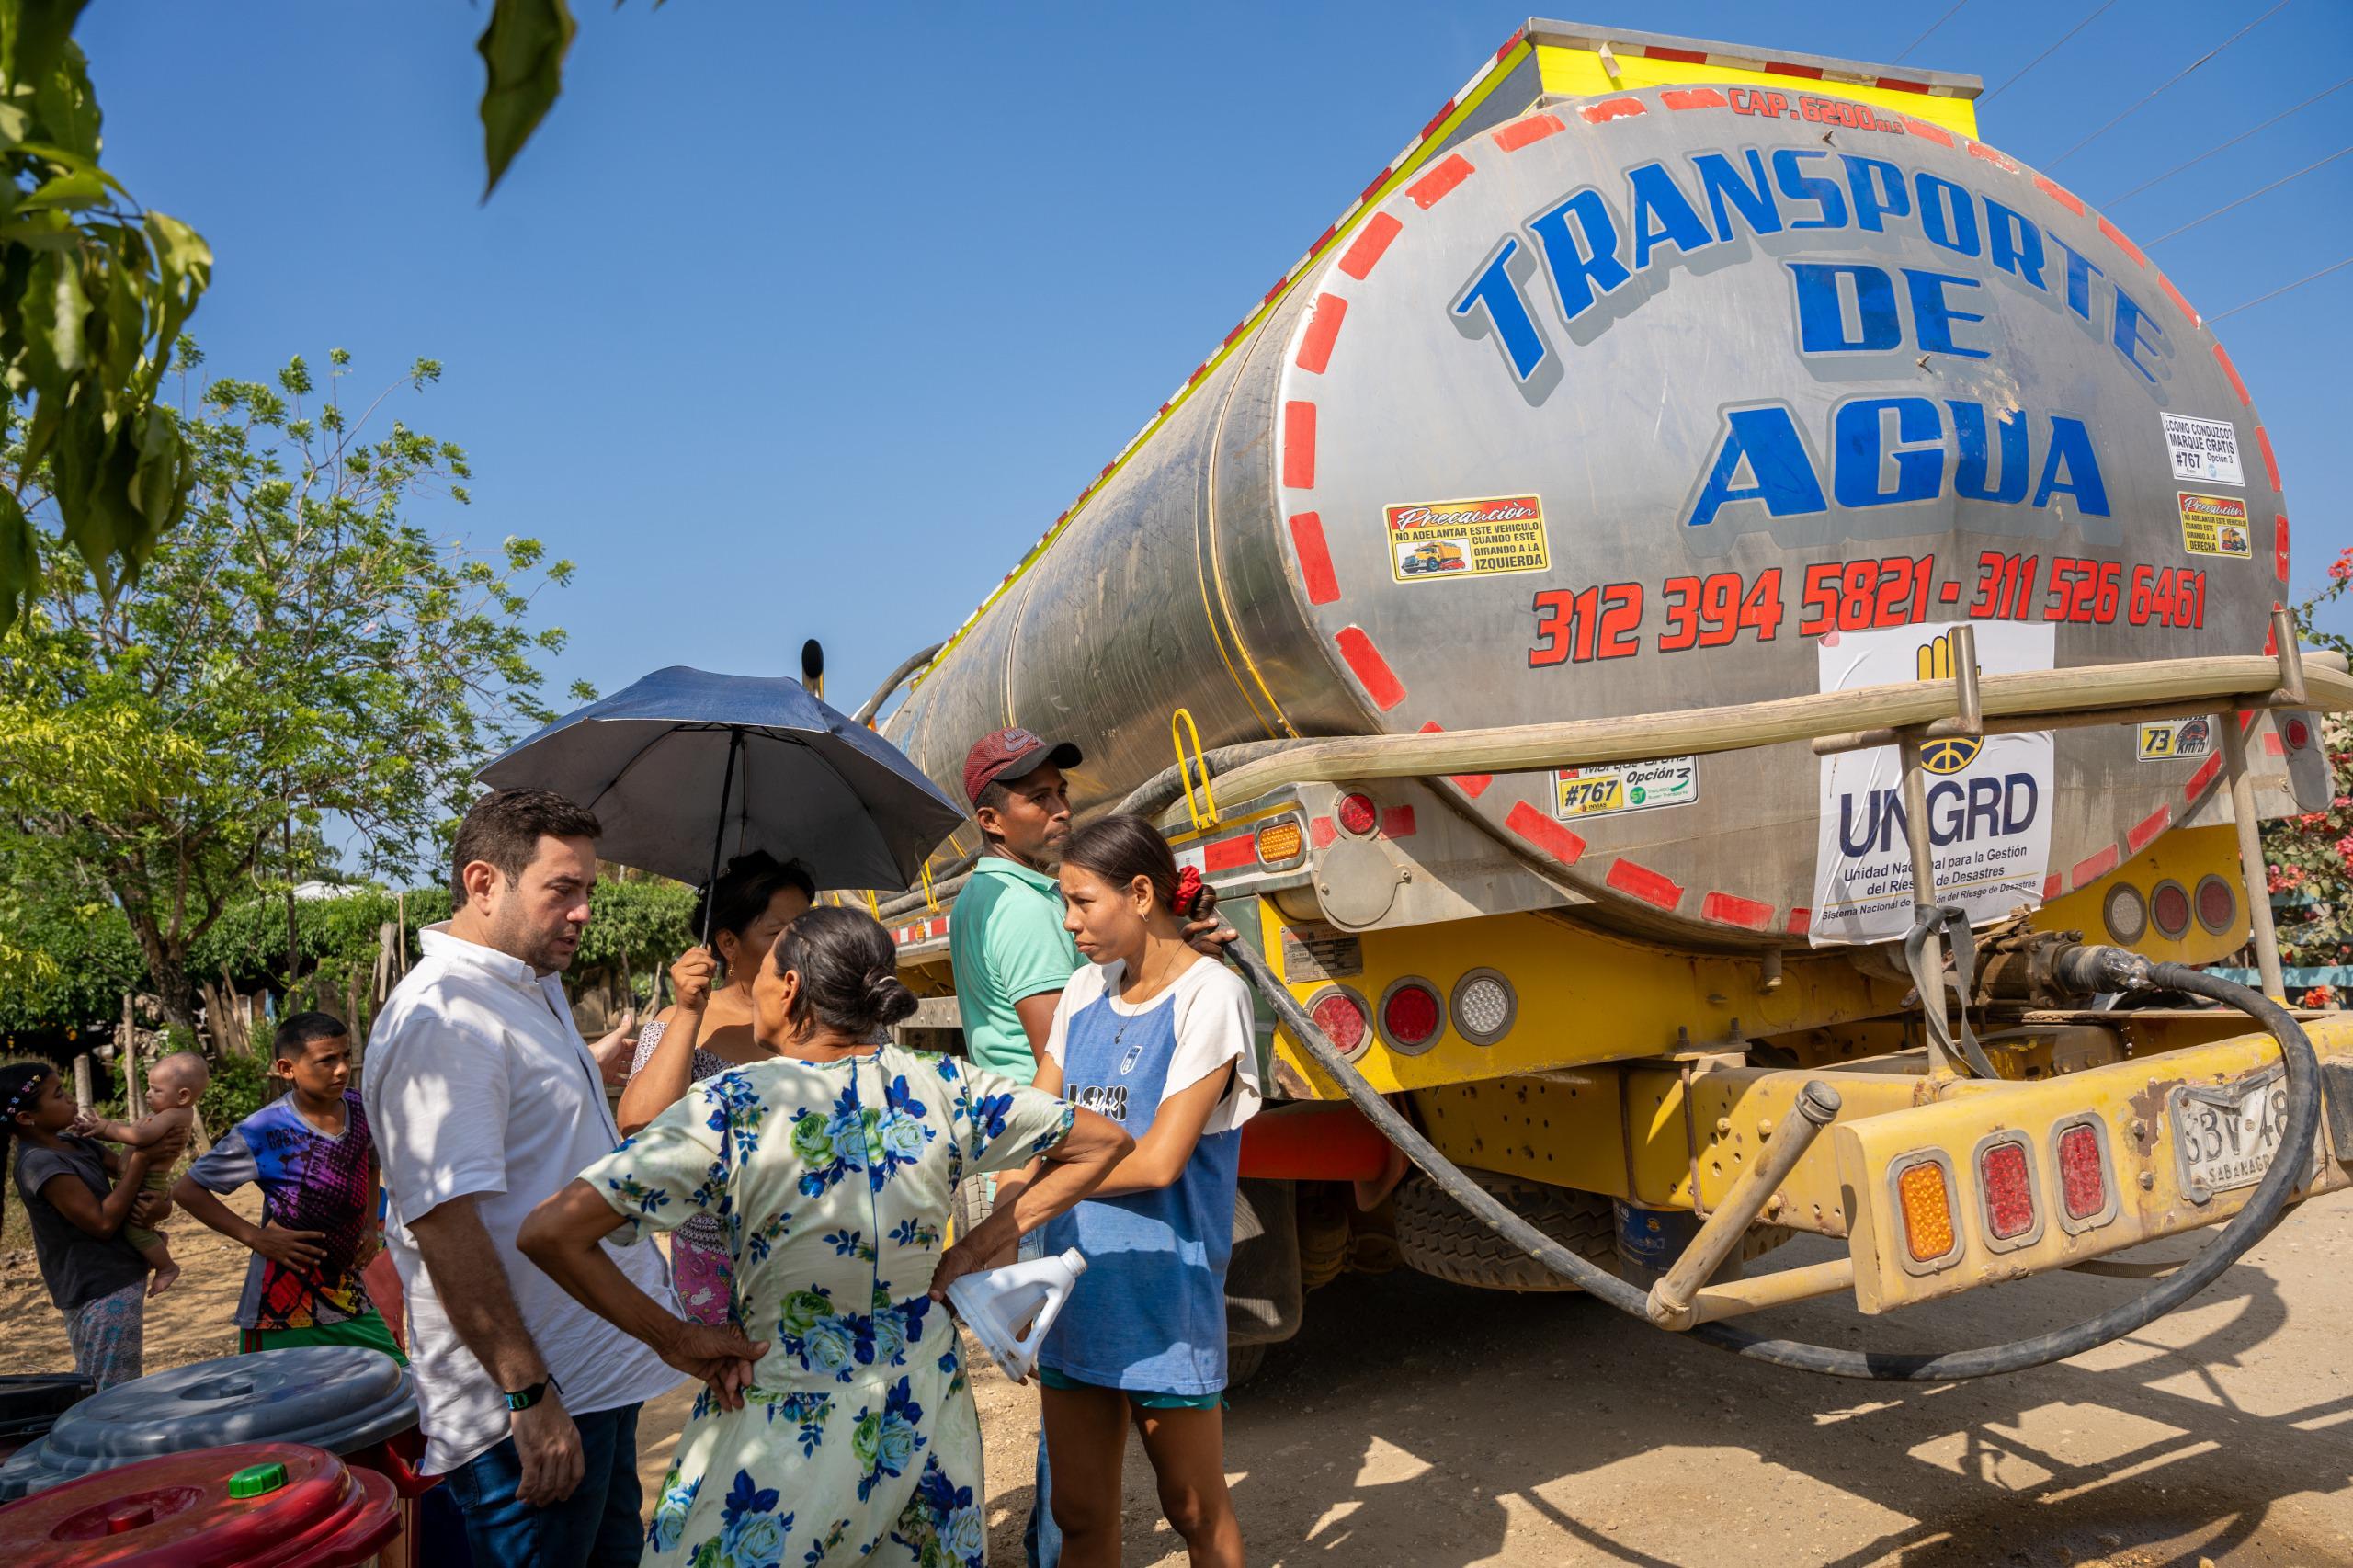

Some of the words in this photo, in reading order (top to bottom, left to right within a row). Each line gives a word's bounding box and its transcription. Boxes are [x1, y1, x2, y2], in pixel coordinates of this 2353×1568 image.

[1453, 150, 2160, 383] TRANSPORTE
[1786, 263, 1992, 360] DE
[2191, 424, 2233, 439] CONDUZCO?
[2169, 433, 2205, 450] MARQUE
[2205, 438, 2234, 455] GRATIS
[1688, 397, 2112, 527] AGUA
[2176, 450, 2200, 469] #767
[2229, 455, 2234, 464] 3
[1395, 531, 1410, 541] NO
[1413, 528, 1468, 540] ADELANTAR
[1470, 527, 1492, 536] ESTE
[1495, 521, 1540, 535] VEHICULO
[1472, 534, 1512, 545] CUANDO
[1514, 531, 1536, 541] ESTE
[2203, 524, 2213, 532] ESTE
[1473, 546, 1517, 557] GIRANDO
[1518, 544, 1526, 553] A
[1528, 542, 1540, 552] LA
[2189, 540, 2217, 551] DERECHA
[1475, 553, 1544, 571] IZQUIERDA
[1528, 583, 1643, 668] 312
[1658, 567, 1784, 653] 394
[1800, 553, 1936, 637] 5821
[1970, 551, 2039, 621] 311
[2043, 557, 2119, 623] 526
[2128, 566, 2207, 630] 6461
[2146, 729, 2171, 752] 73
[1564, 779, 1619, 807] #767
[1626, 767, 1675, 785] Opción
[1839, 772, 2039, 858] UNGRD
[1844, 864, 1889, 882] Unidad
[1948, 855, 1972, 870] para
[1974, 851, 1984, 863] la
[1987, 845, 2028, 861] Gestión
[1867, 882, 1886, 895] del
[1890, 880, 1915, 892] Ries
[1936, 874, 1949, 887] de
[1952, 867, 2005, 883] Desastres
[1823, 908, 1858, 921] Sistema
[1859, 900, 1898, 915] Nacional
[1900, 898, 1911, 907] de
[1947, 892, 1959, 902] del
[1961, 889, 1987, 898] Riesgo
[1988, 886, 1998, 894] de
[2000, 881, 2037, 892] Desastres
